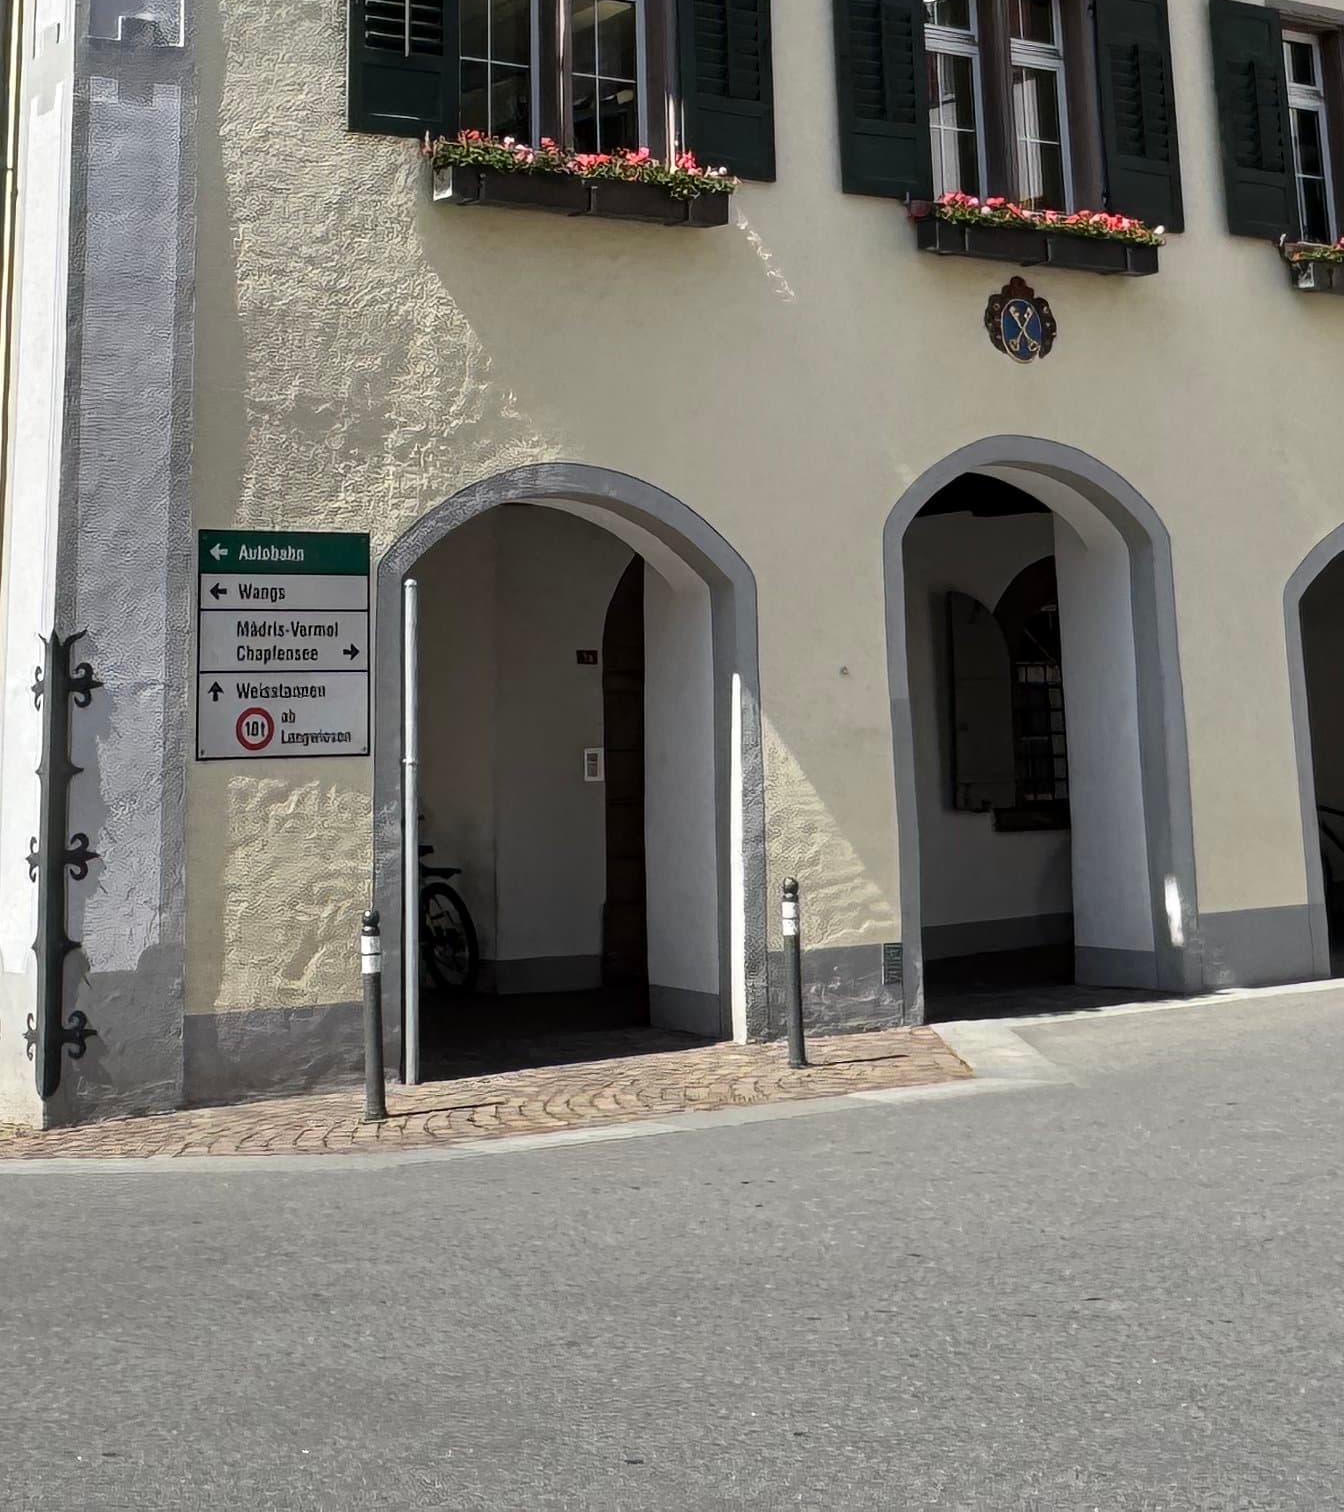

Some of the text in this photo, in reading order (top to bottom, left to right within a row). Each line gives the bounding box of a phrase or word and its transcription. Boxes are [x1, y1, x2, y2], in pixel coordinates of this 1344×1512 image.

[238, 544, 305, 562] Autobahn
[238, 583, 286, 603] Wangs
[237, 620, 339, 638] Mädris-Vermol
[237, 682, 326, 699] Weisstannen
[281, 709, 296, 723] ab
